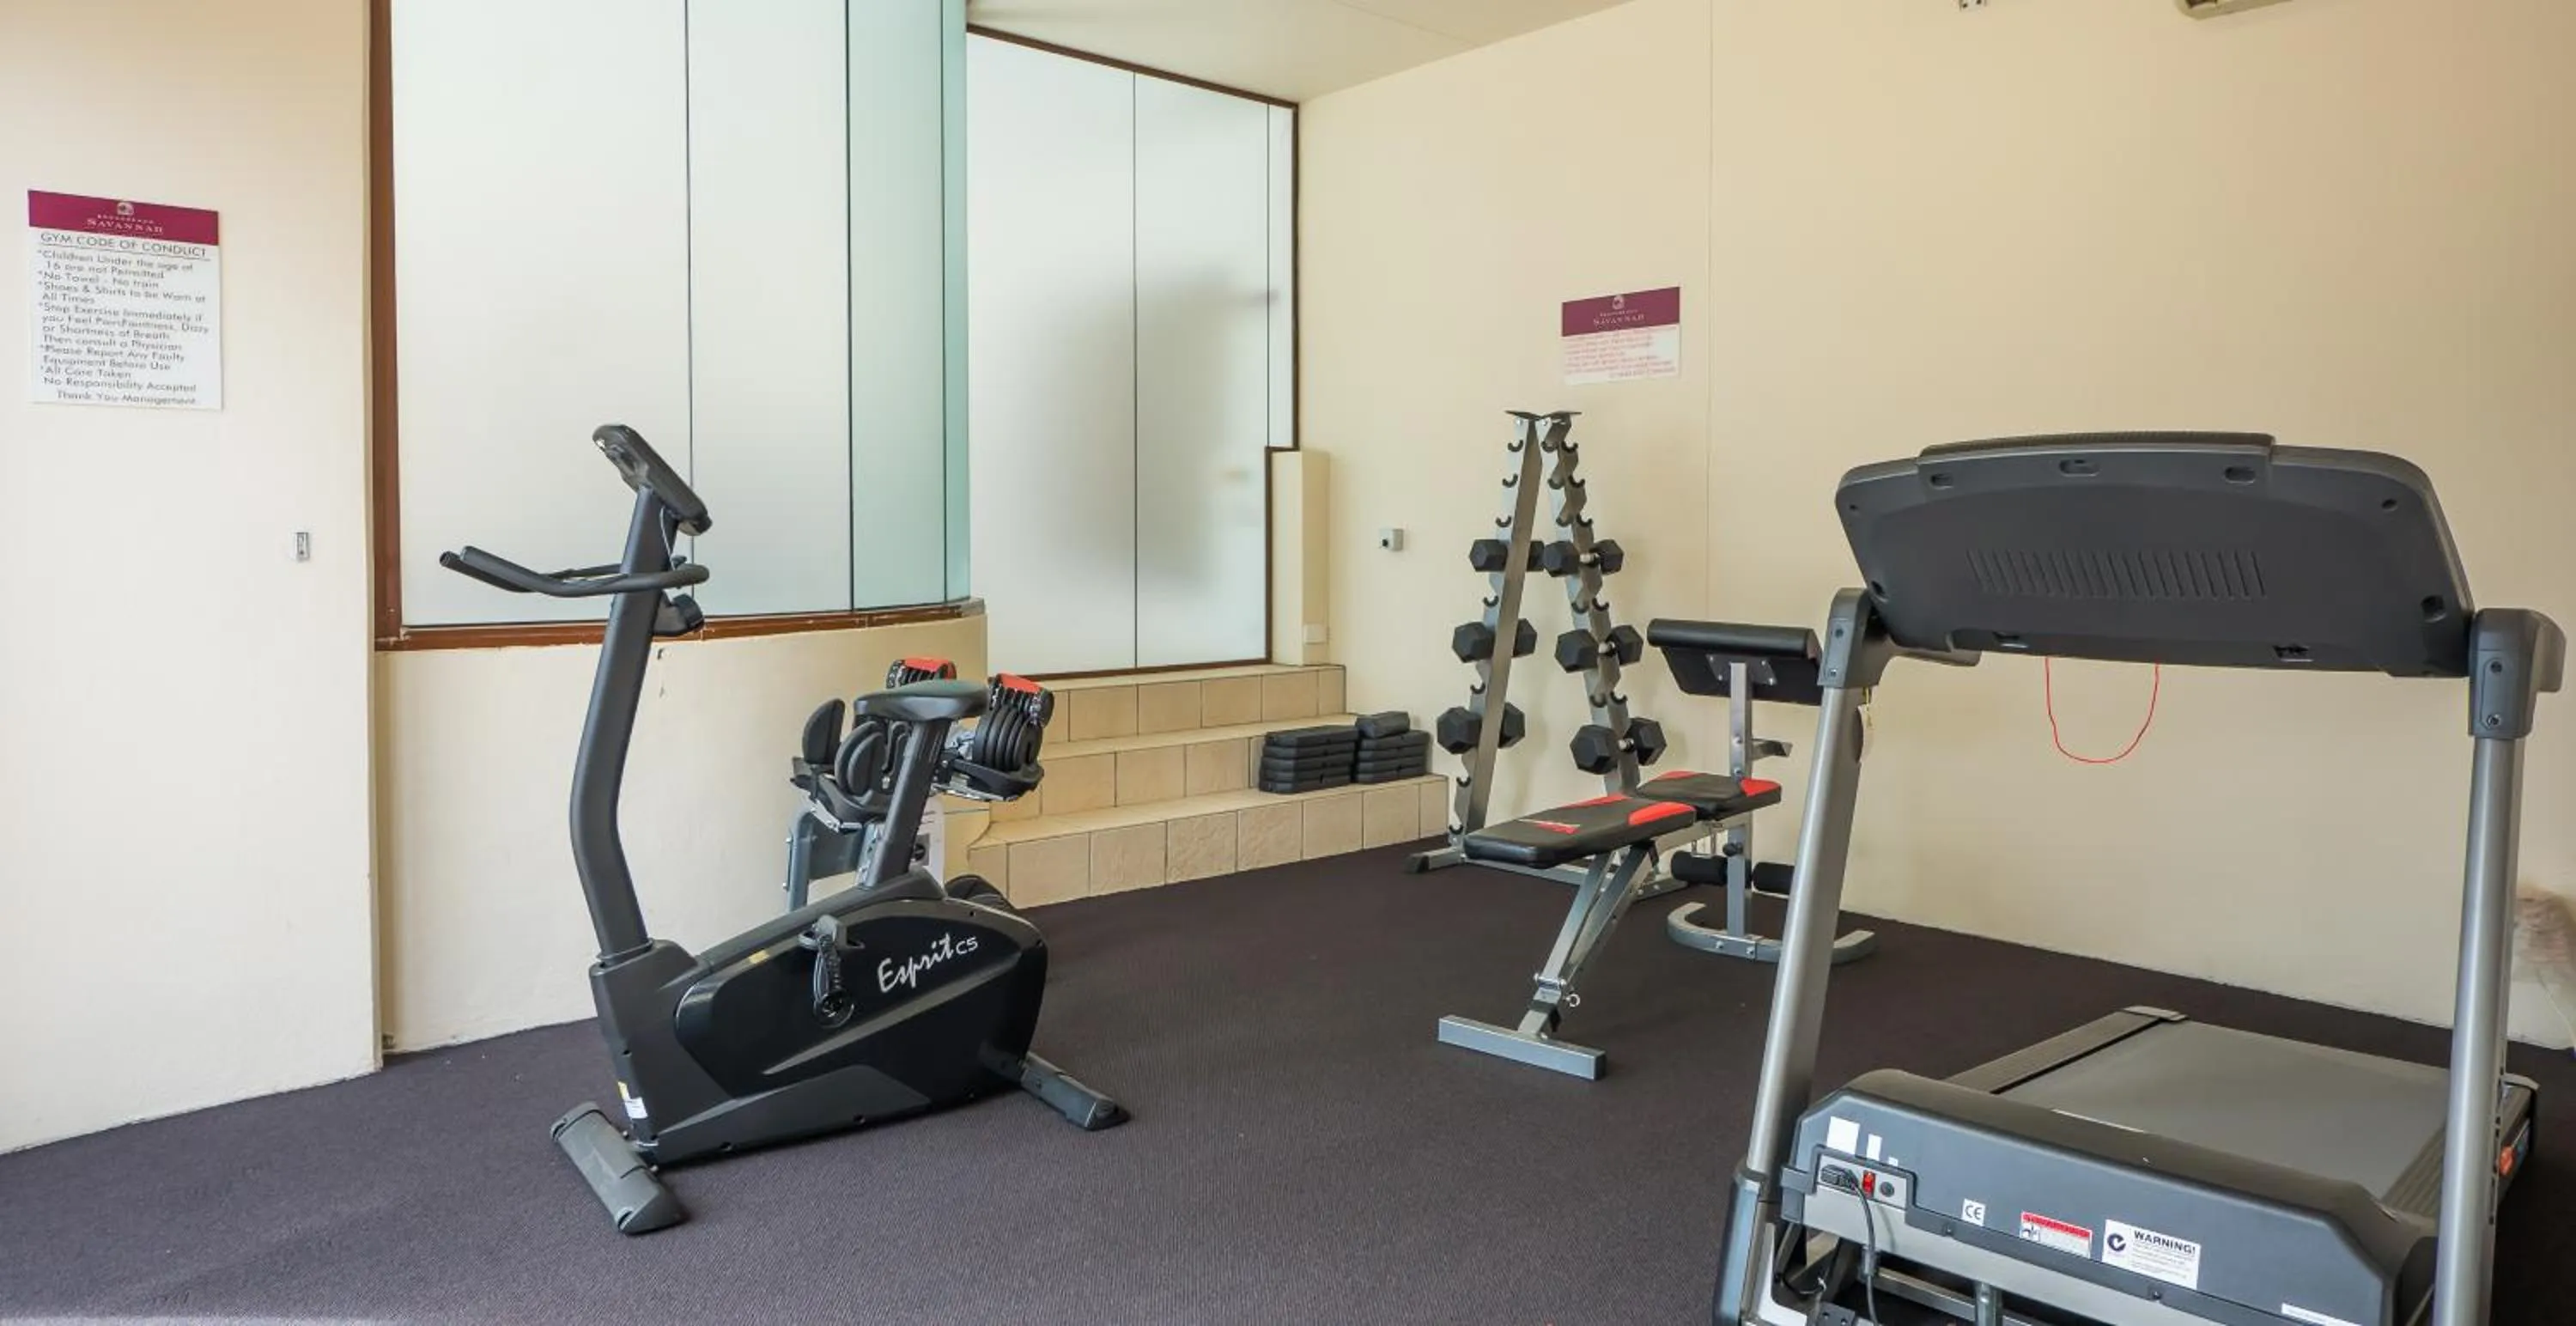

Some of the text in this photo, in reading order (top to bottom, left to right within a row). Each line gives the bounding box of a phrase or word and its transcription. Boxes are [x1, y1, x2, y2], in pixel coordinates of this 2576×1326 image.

[40, 232, 206, 257] GYM CODE OF CONDUCT
[47, 261, 61, 270] 16
[88, 265, 107, 273] not
[111, 266, 164, 278] Permitted
[65, 272, 99, 283] Towel
[112, 277, 130, 286] No
[75, 305, 119, 316] Exercise
[99, 368, 131, 378] Taken
[150, 362, 171, 370] Use
[44, 377, 62, 386] No
[147, 382, 197, 393] Accepted
[878, 932, 978, 993] Esprit C5
[1965, 1205, 1983, 1220] CE
[2134, 1230, 2196, 1255] WARNING!
